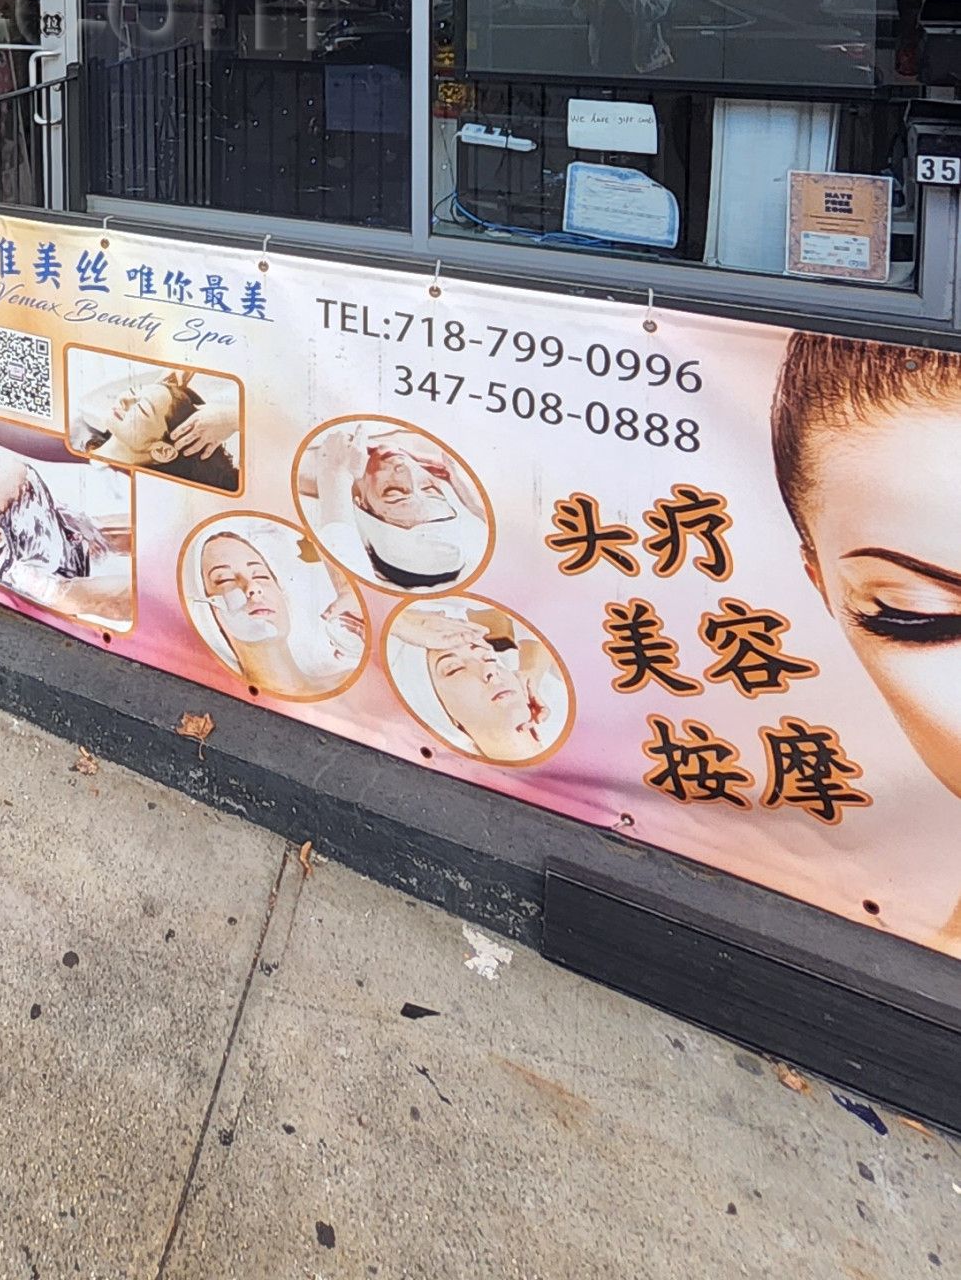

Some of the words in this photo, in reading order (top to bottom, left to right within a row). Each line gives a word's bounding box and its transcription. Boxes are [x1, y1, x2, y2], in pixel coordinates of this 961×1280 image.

[920, 157, 957, 181] 35
[63, 298, 162, 343] Beauty
[173, 318, 237, 352] Spa
[126, 263, 269, 319] 唯你最美
[316, 298, 703, 394] TEL:718-799-0996
[394, 365, 701, 453] 347-508-0888
[547, 484, 733, 581] 头疗
[602, 597, 818, 699] 美容
[643, 713, 873, 825] 按摩
